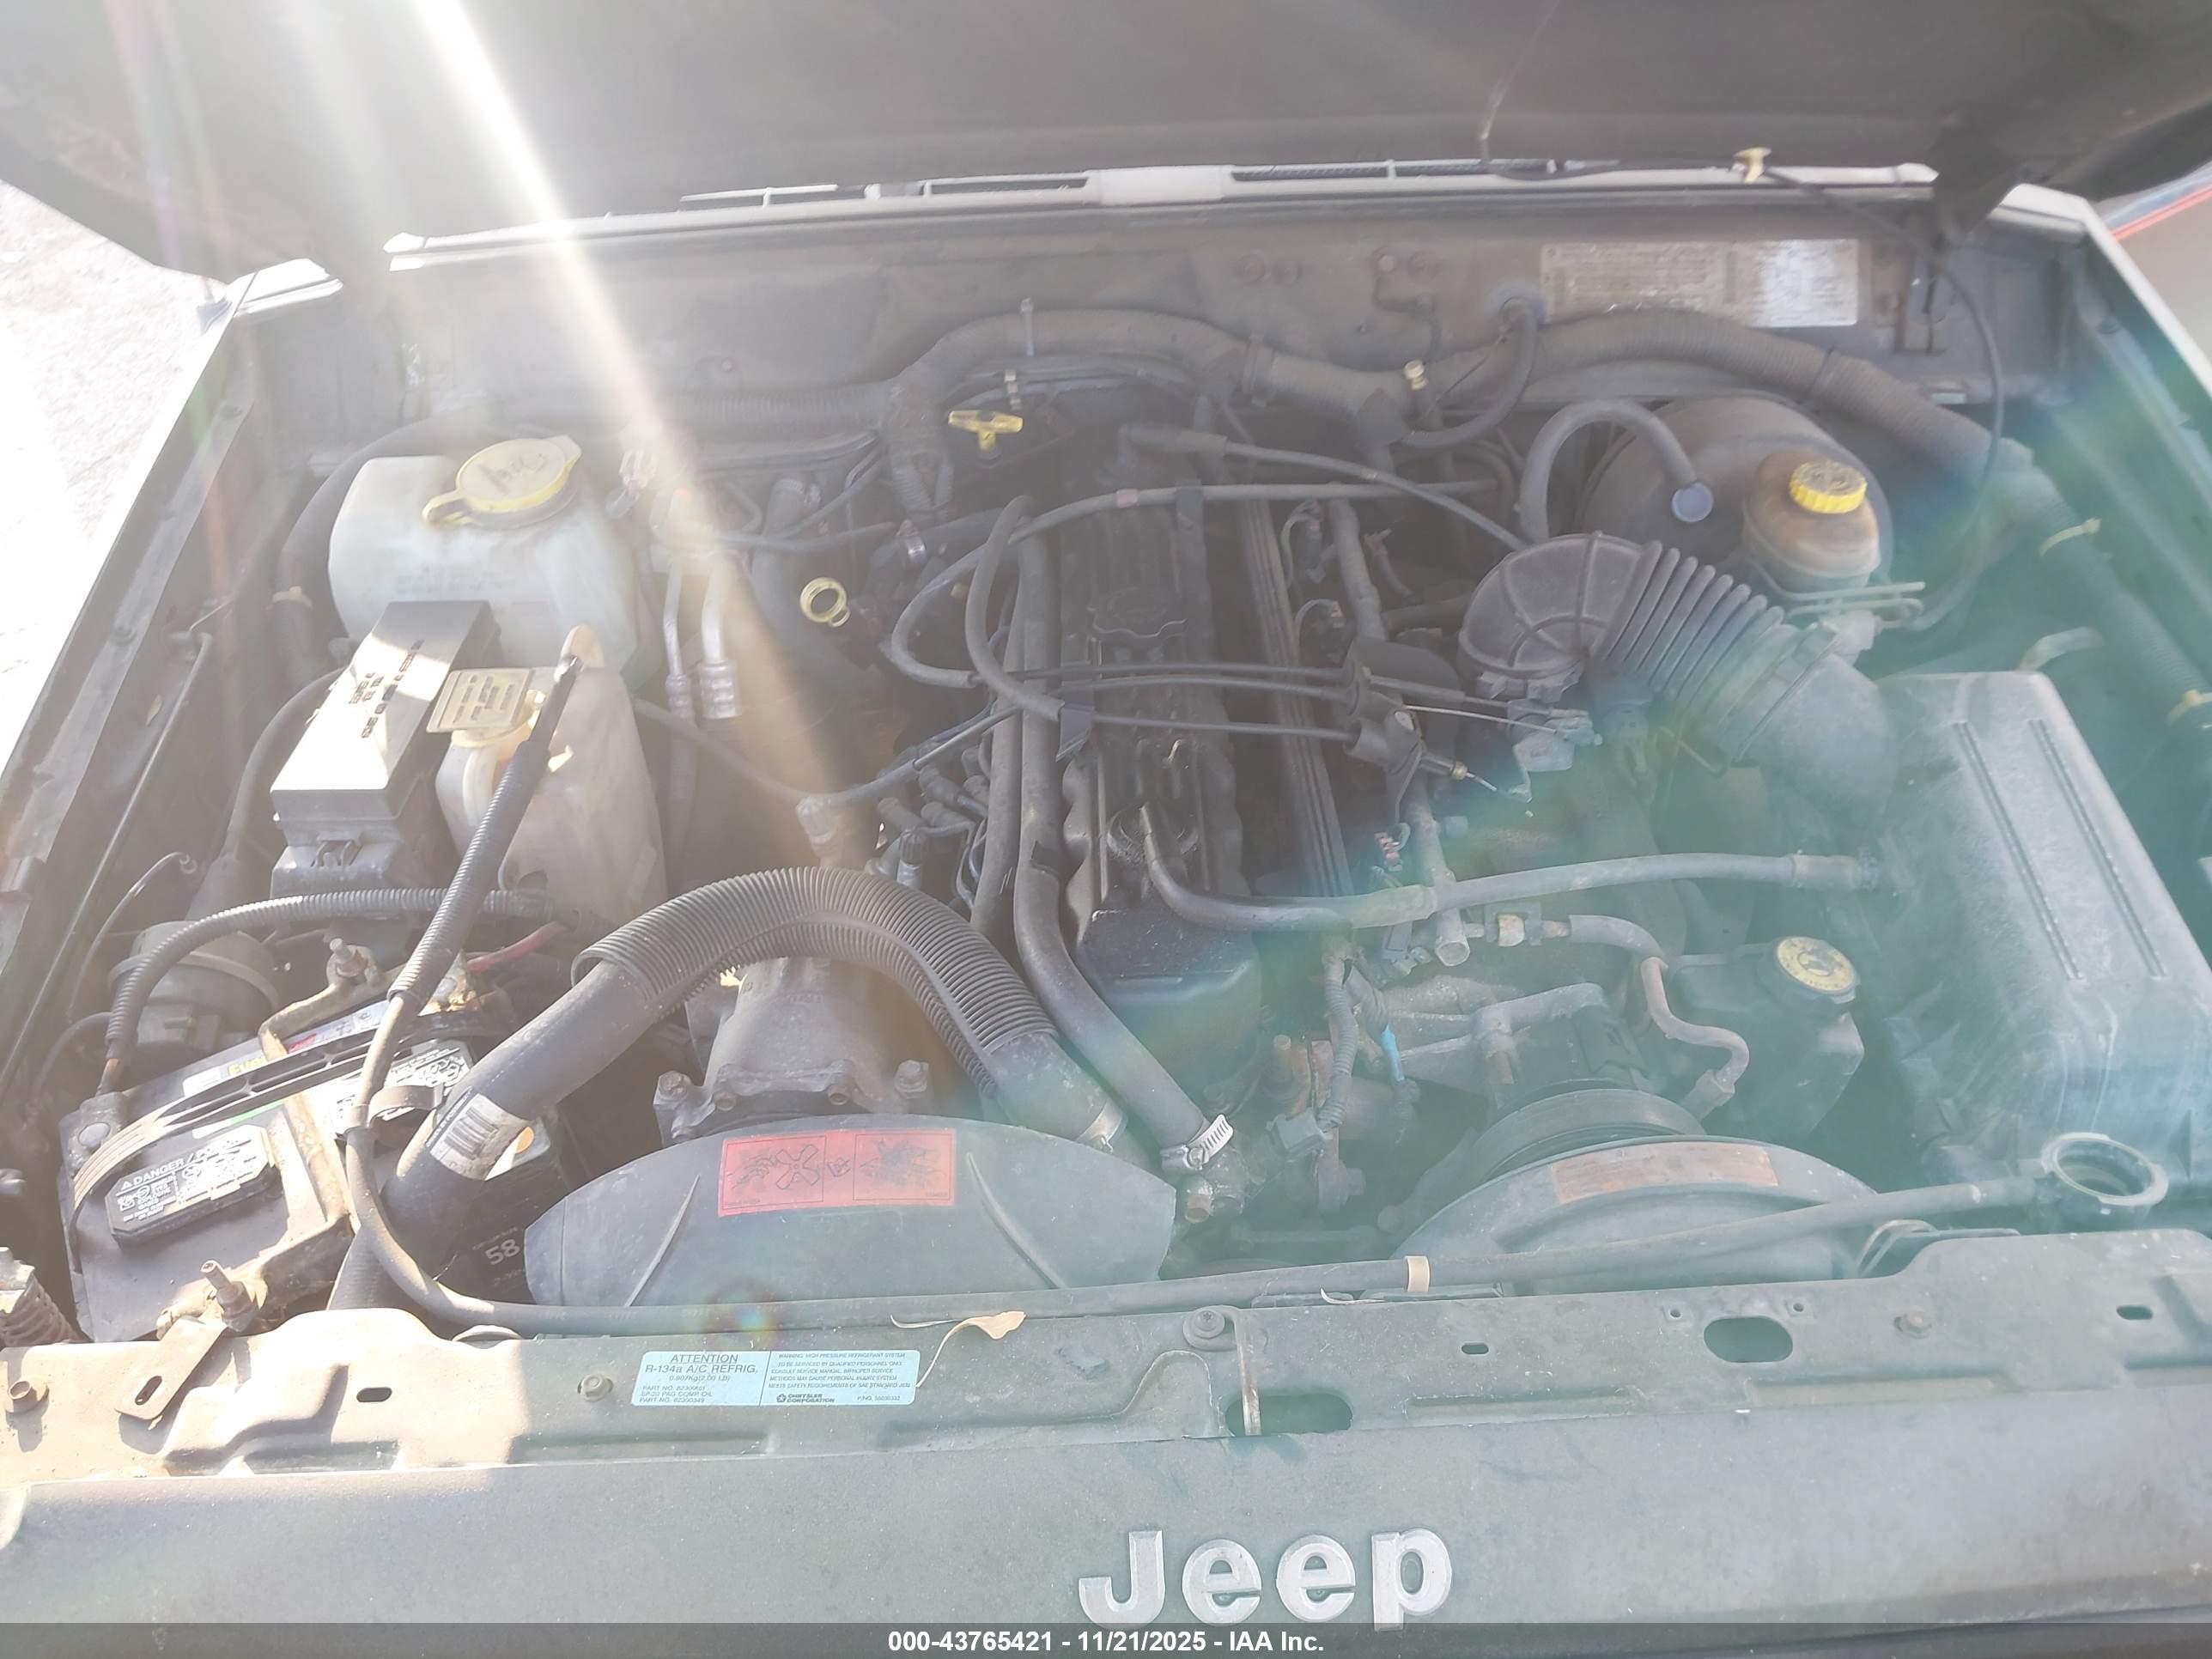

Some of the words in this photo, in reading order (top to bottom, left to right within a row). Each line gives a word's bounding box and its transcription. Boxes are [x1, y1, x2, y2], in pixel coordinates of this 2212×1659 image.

[135, 1159, 185, 1184] DANGER
[485, 1239, 520, 1265] 58
[645, 1364, 683, 1373] R-134a
[686, 1364, 708, 1373] A/C
[711, 1364, 758, 1373] REFRIG.
[671, 1354, 738, 1364] ATTENTION
[1078, 1528, 1454, 1632] Jeep
